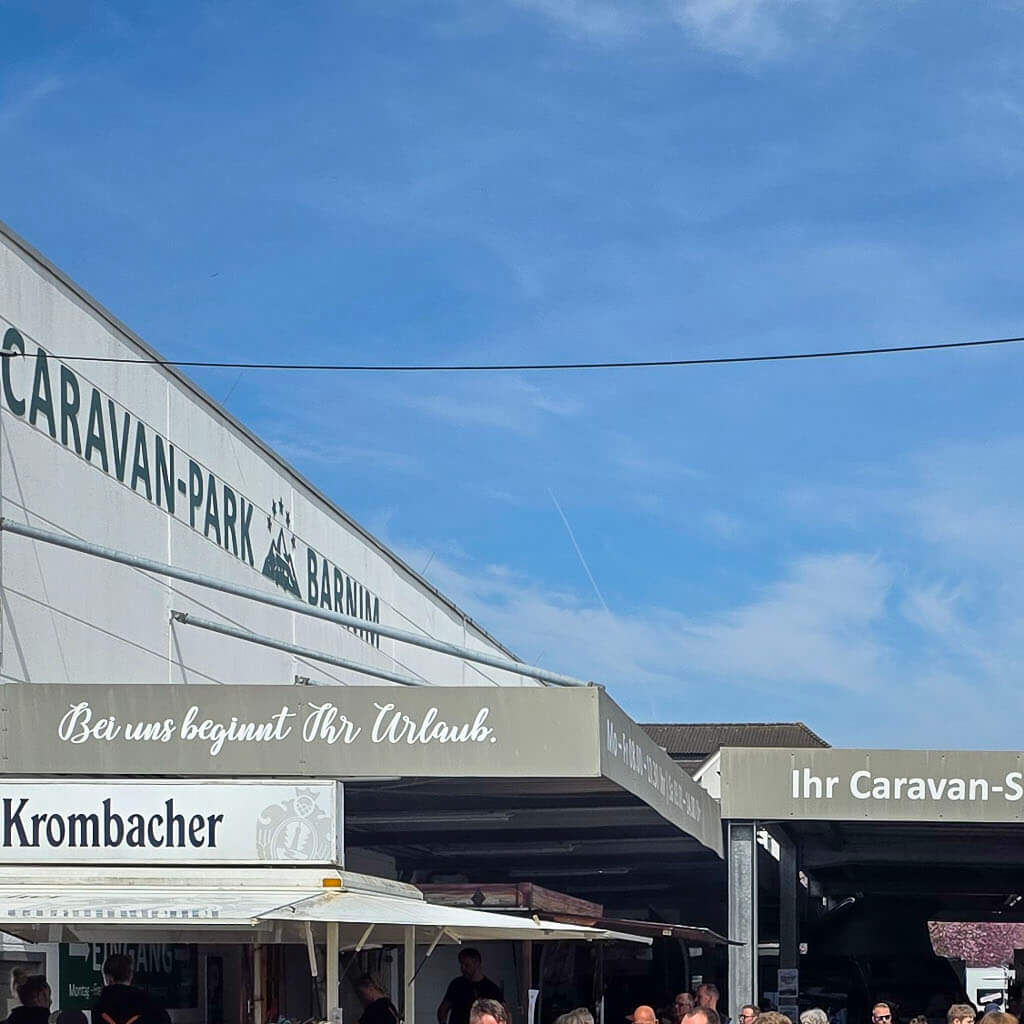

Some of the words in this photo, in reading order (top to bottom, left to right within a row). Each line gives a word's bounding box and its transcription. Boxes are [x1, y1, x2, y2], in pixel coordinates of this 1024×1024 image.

[2, 328, 254, 567] CARAVAN-PARK
[307, 547, 380, 650] BARNIM
[57, 702, 121, 744] Bei
[124, 718, 177, 742] uns
[180, 706, 297, 756] beginnt
[302, 702, 361, 744] Ihr
[371, 702, 497, 744] Urlaub.
[791, 768, 840, 799] Ihr
[2, 798, 225, 848] Krombacher
